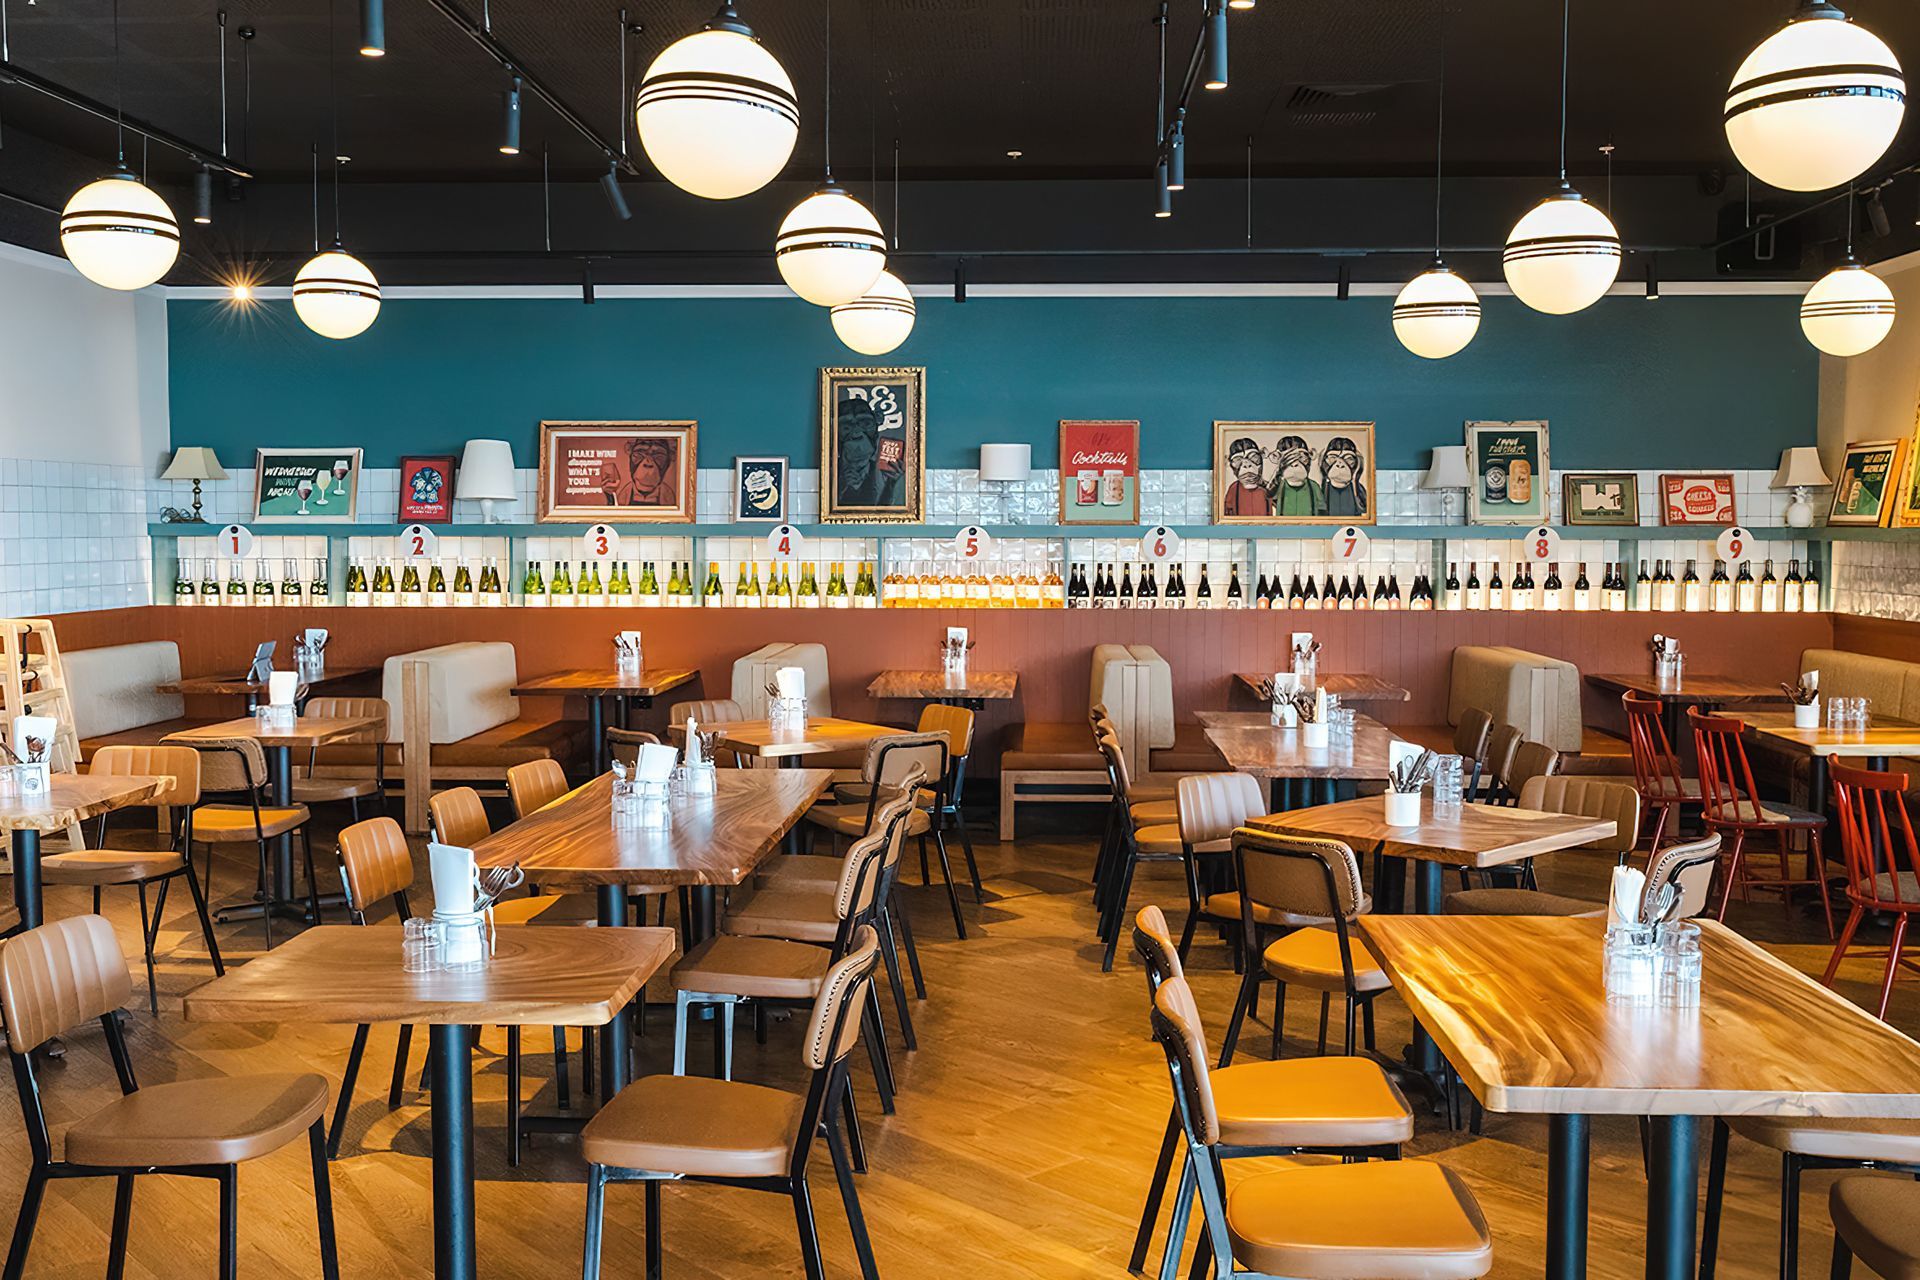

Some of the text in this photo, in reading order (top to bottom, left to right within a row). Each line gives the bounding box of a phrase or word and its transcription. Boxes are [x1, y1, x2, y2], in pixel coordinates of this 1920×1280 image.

[1071, 450, 1128, 466] Cocktails
[567, 477, 590, 486] YOUR
[231, 537, 239, 554] 1
[412, 535, 424, 555] 2
[595, 535, 609, 555] 3
[777, 536, 791, 556] 4
[965, 537, 978, 557] 5
[1154, 539, 1166, 557] 6
[1343, 537, 1357, 558] 7
[1535, 538, 1549, 559] 8
[1729, 538, 1743, 559] 9
